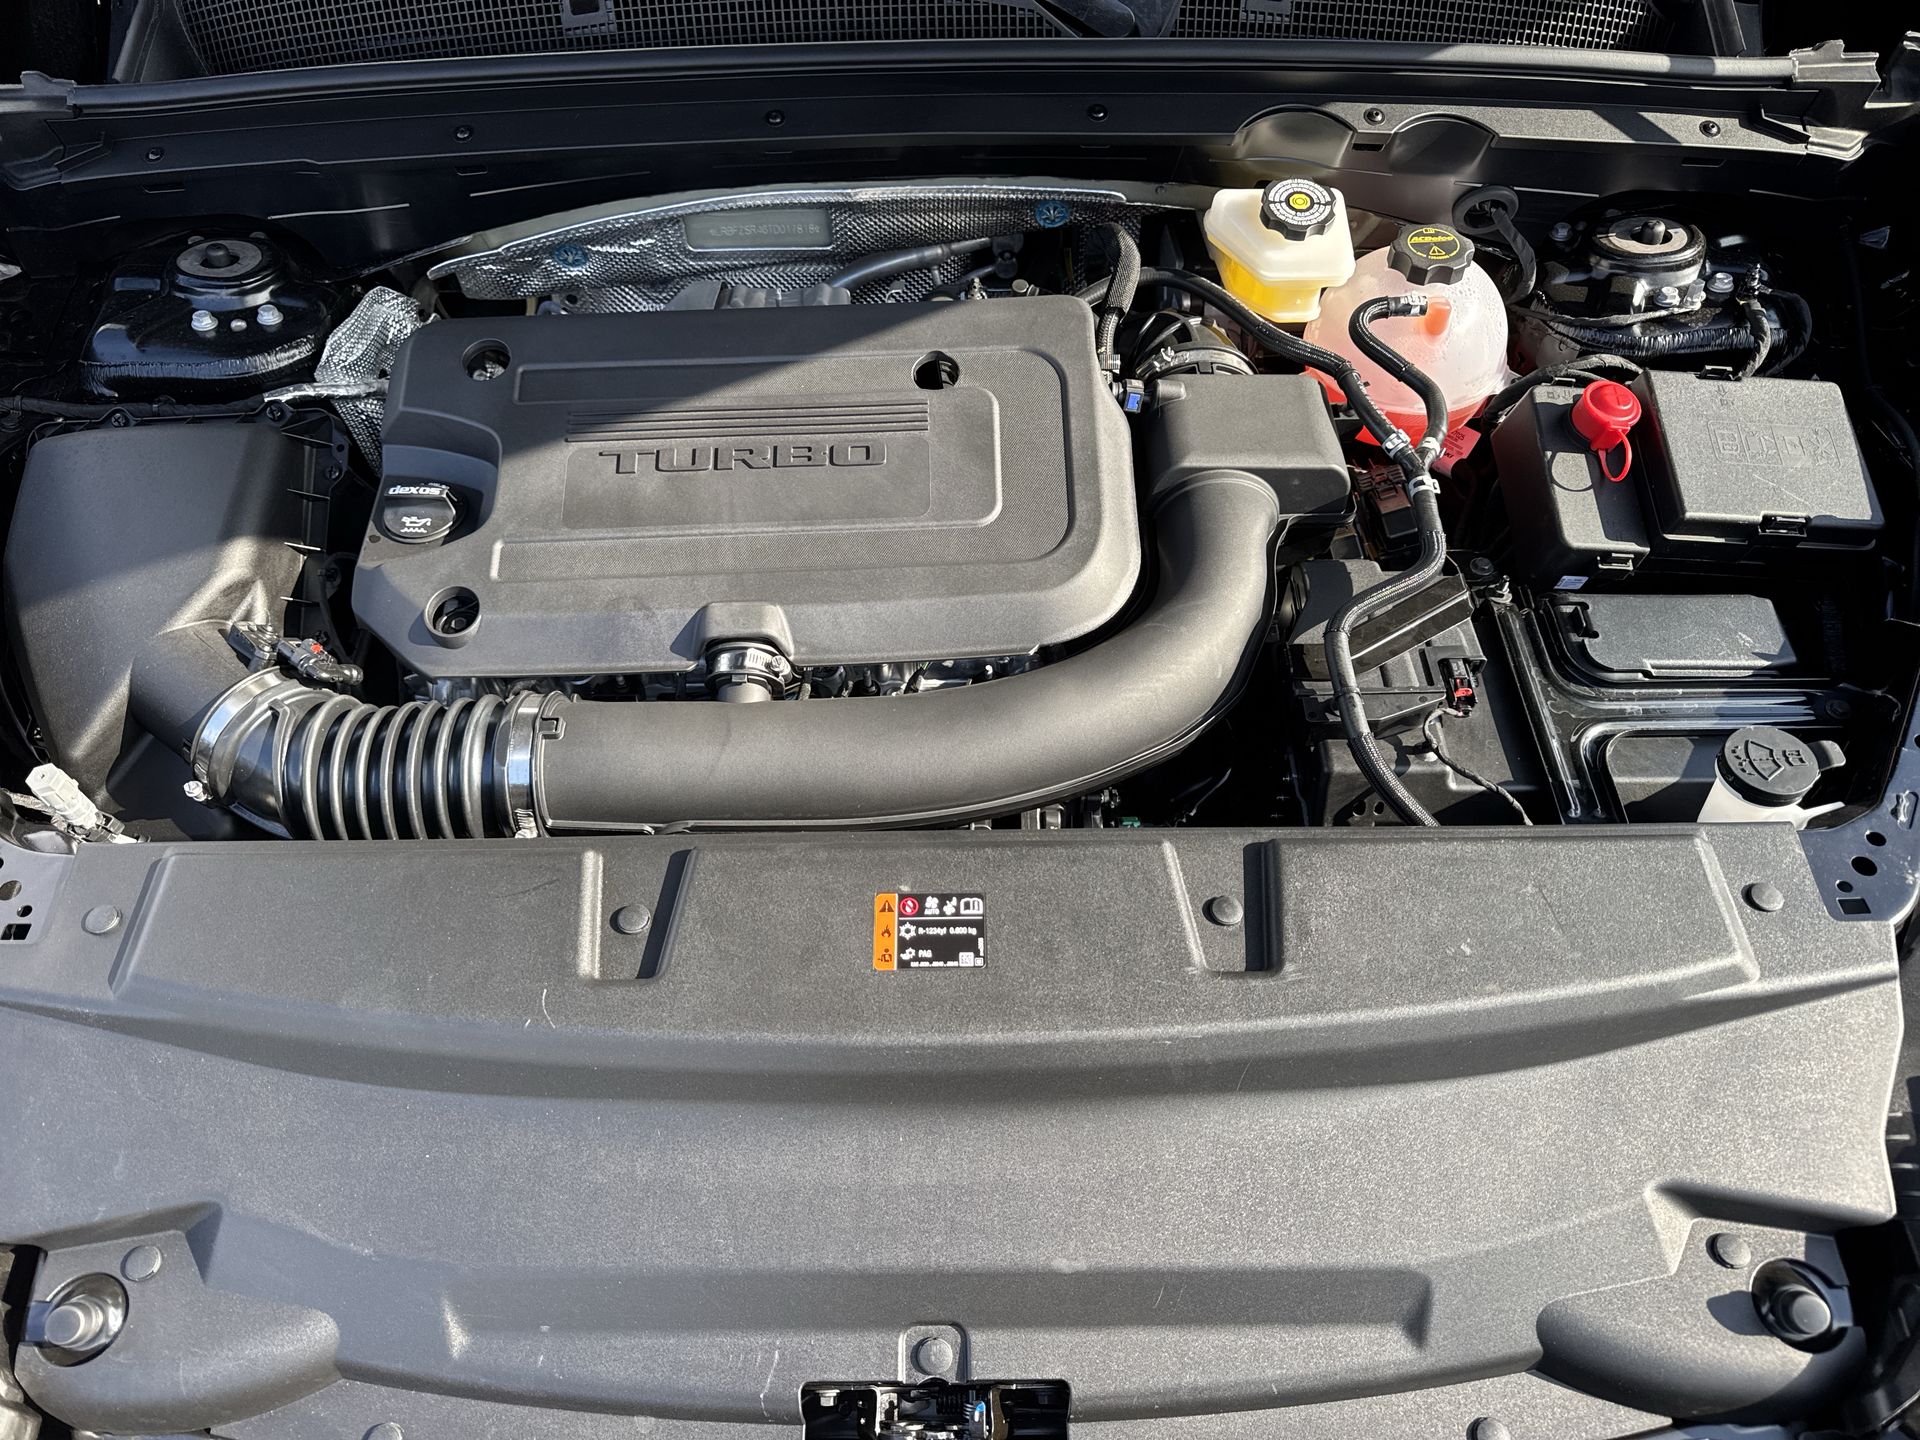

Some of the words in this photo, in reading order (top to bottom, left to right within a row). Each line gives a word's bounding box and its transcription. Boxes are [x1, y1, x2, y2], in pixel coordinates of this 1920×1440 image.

[599, 442, 887, 474] TURBO
[388, 485, 442, 495] dexos
[918, 927, 947, 936] R-1234yf
[968, 926, 977, 936] kg
[918, 949, 932, 958] PAG
